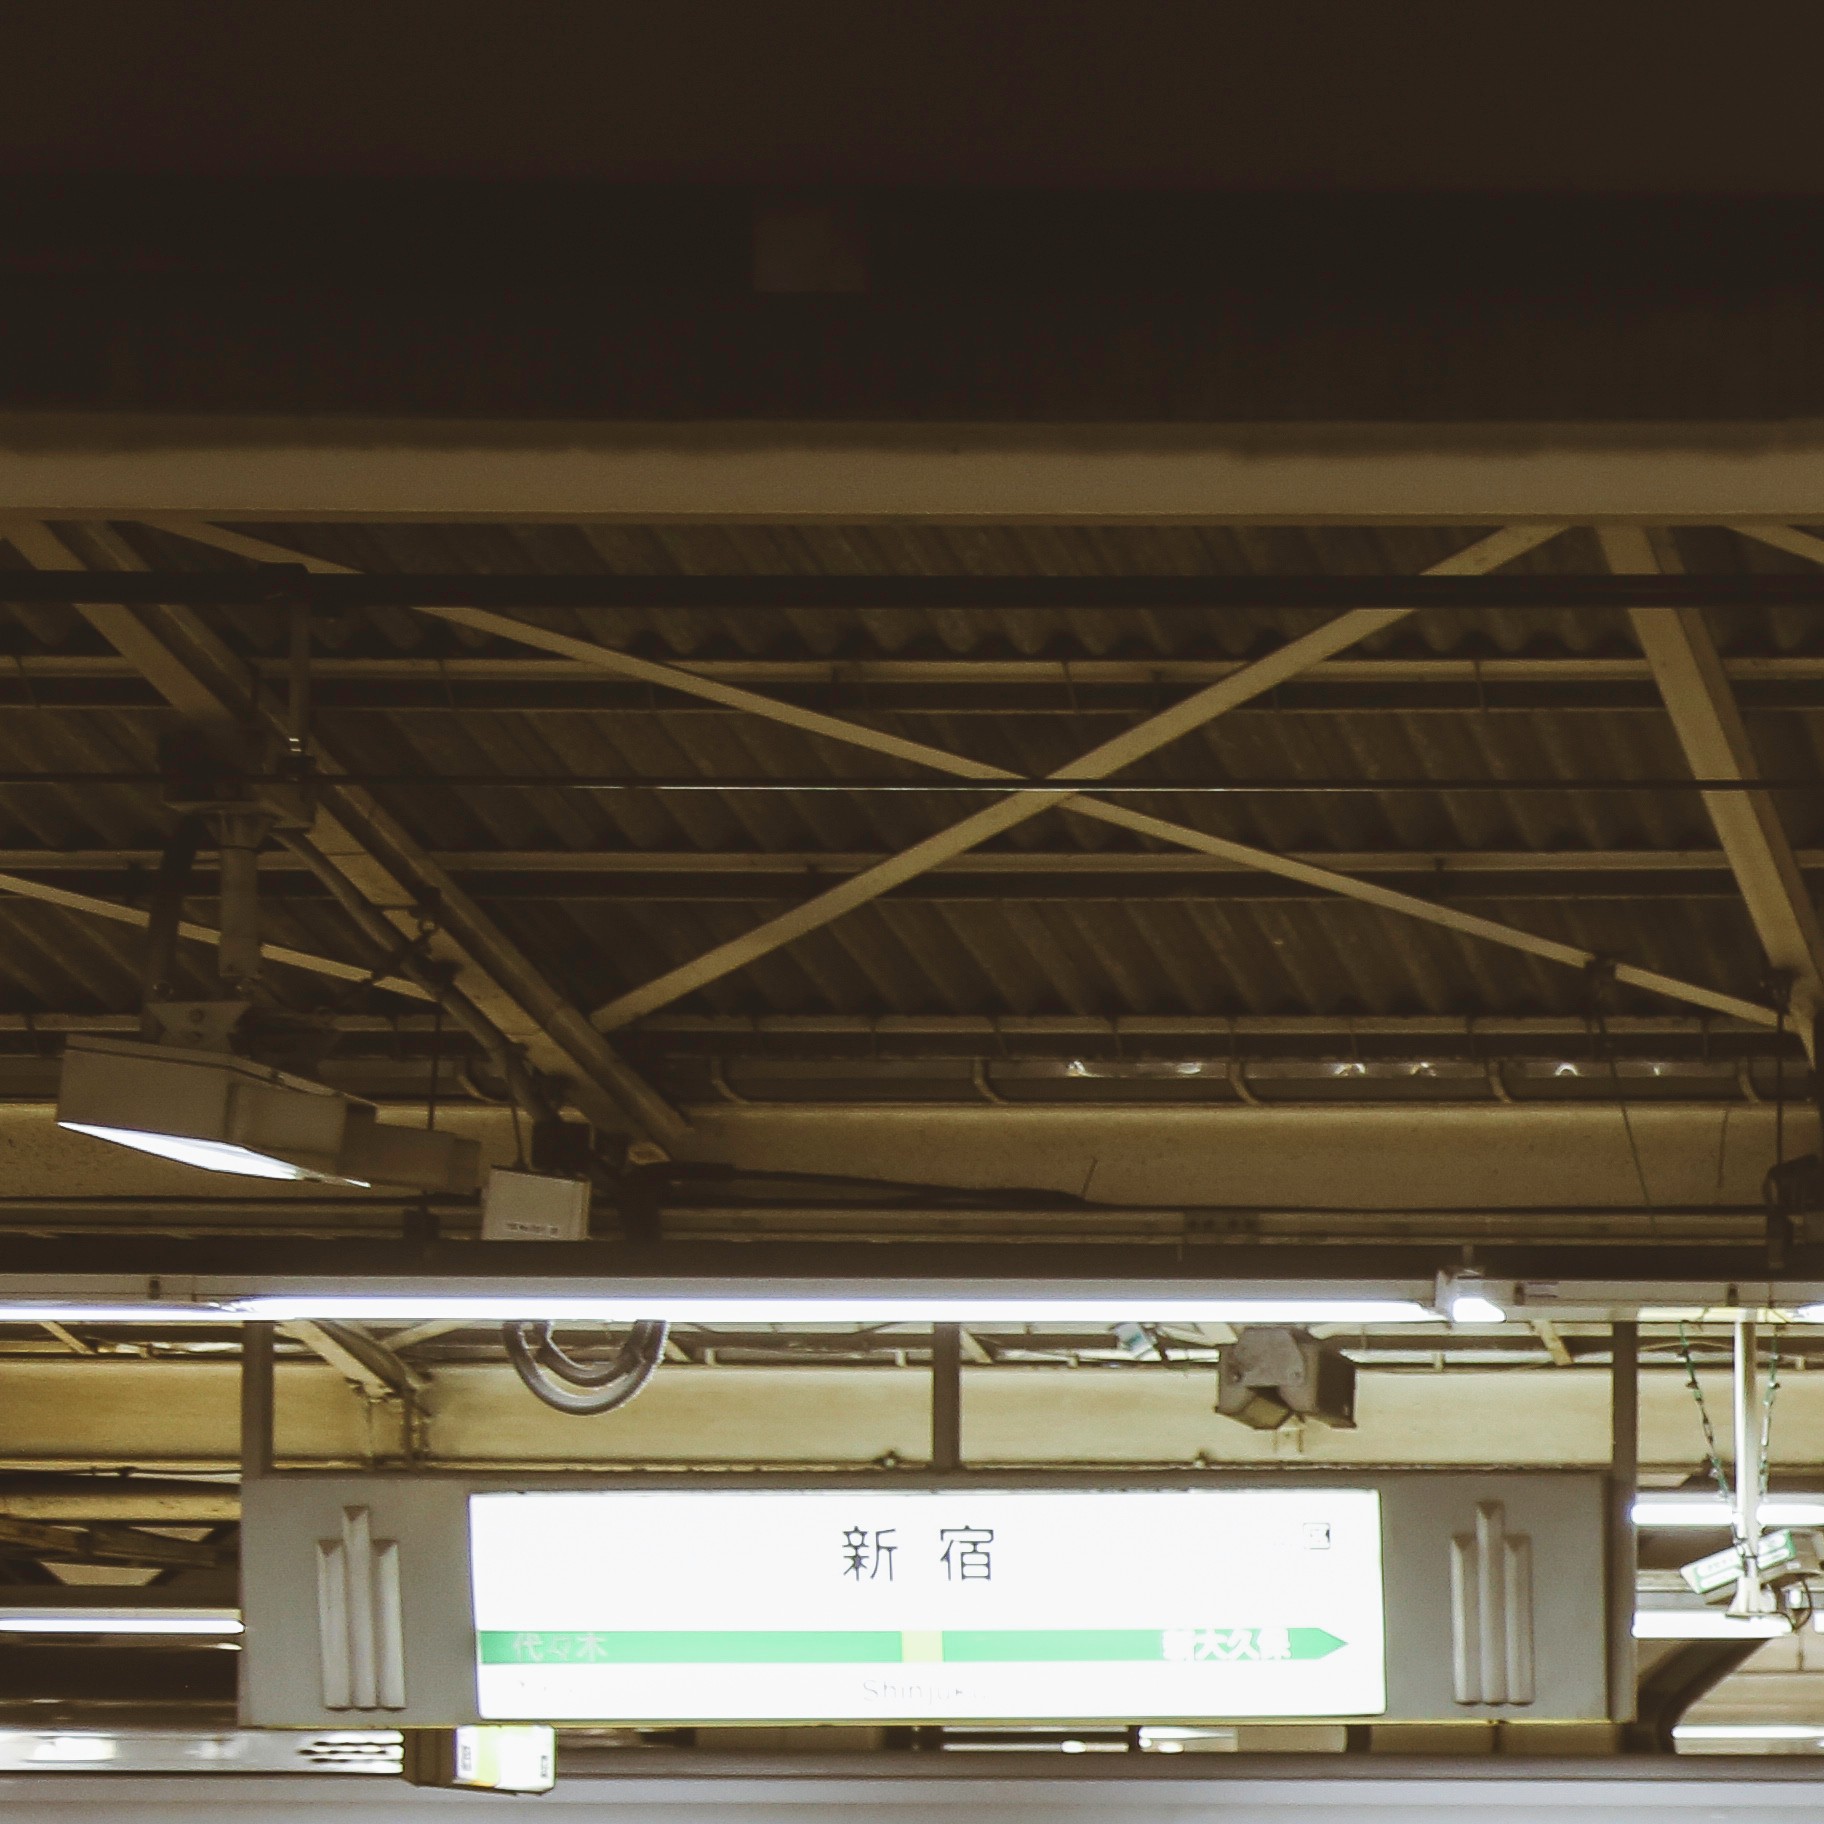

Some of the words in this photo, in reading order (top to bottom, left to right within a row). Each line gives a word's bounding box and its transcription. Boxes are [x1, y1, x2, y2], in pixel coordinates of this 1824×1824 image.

[842, 1525, 994, 1581] 新宿
[511, 1632, 608, 1662] 代々木
[1162, 1628, 1292, 1661] 大久
[862, 1679, 988, 1705] Shinju
